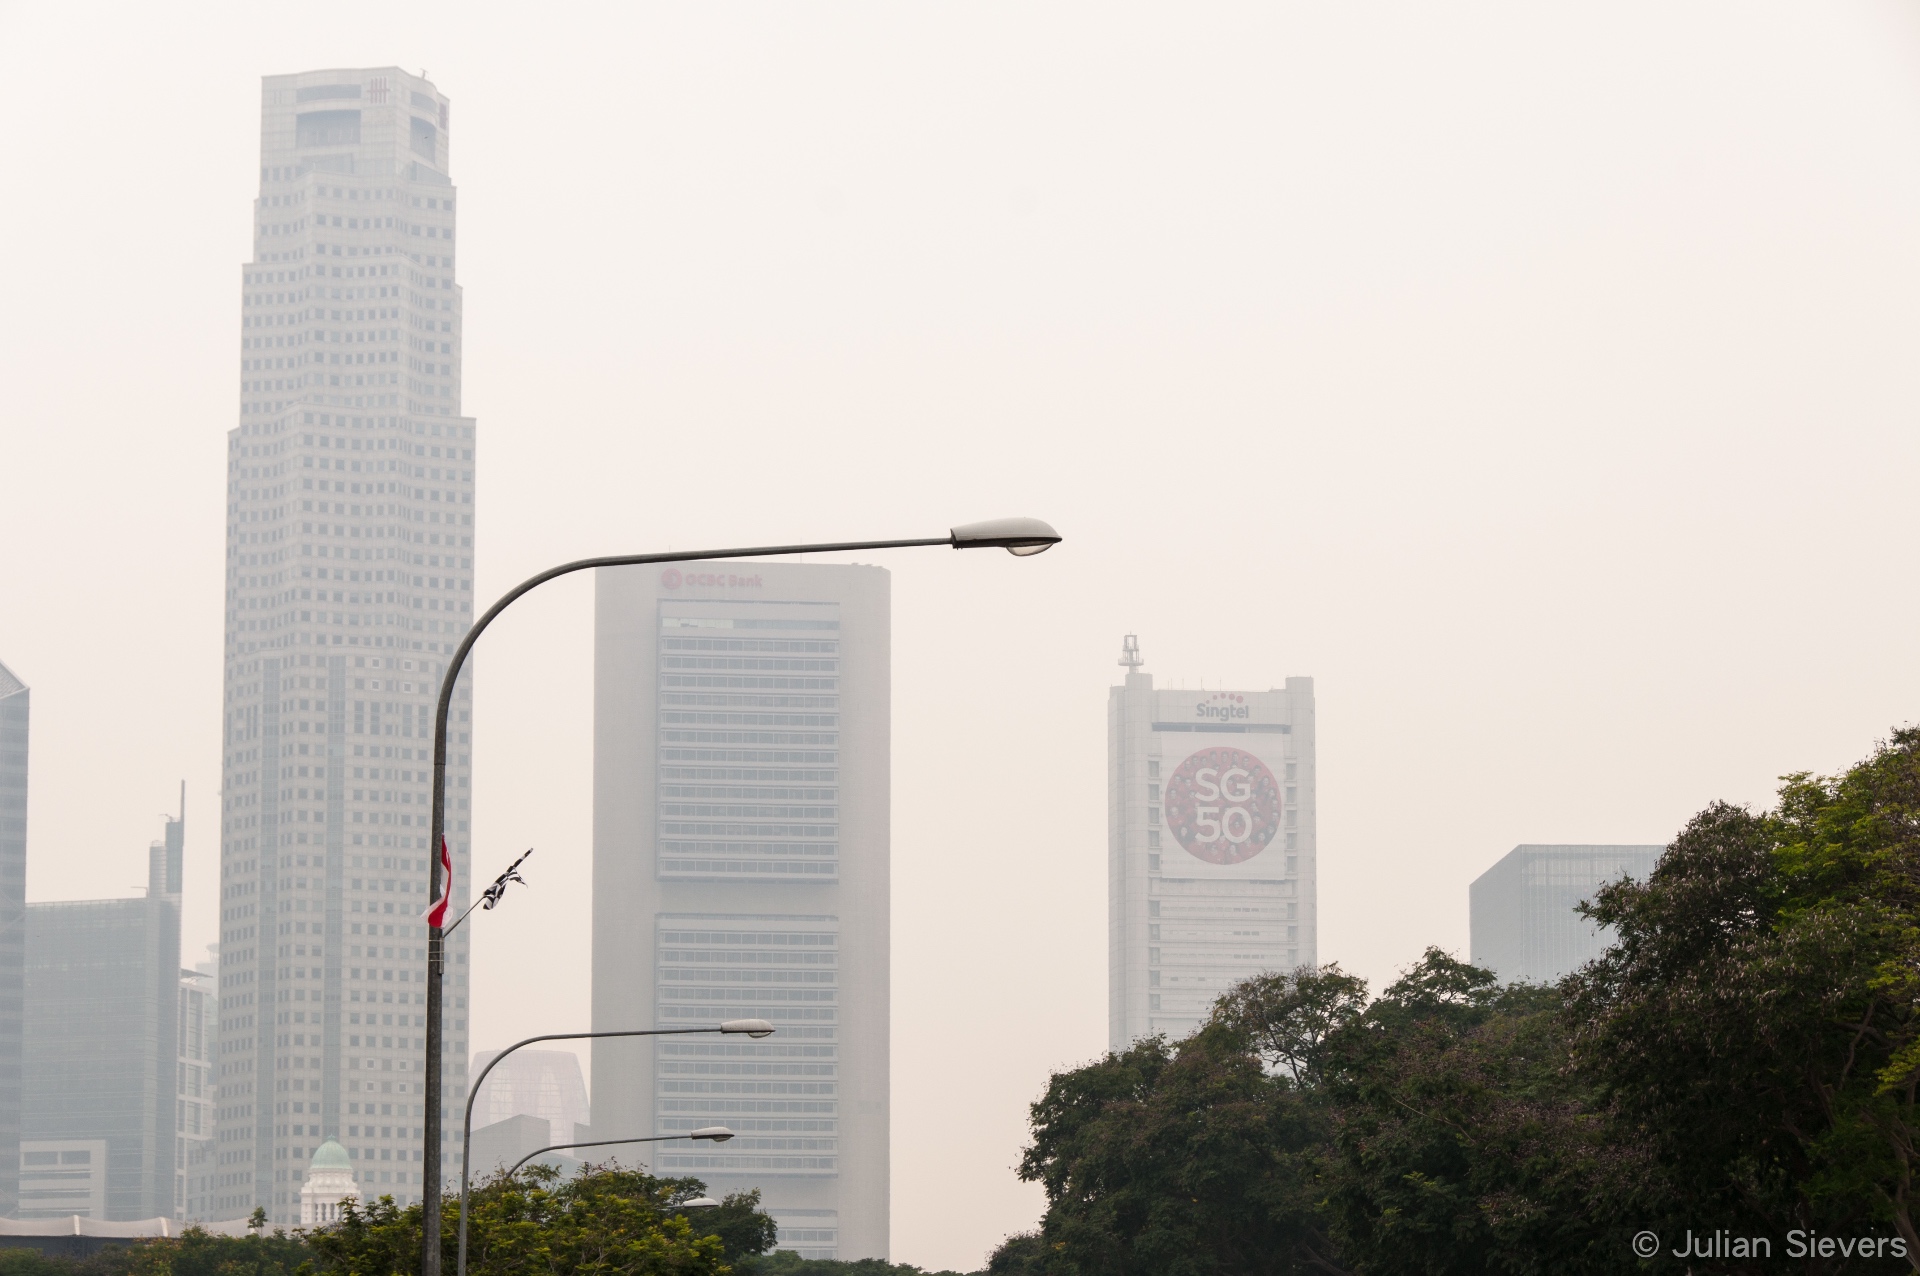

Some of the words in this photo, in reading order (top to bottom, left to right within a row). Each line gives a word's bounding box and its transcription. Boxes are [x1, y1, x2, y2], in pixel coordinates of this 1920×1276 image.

[685, 573, 725, 587] OCBC
[728, 573, 763, 587] Bank
[1196, 702, 1249, 722] Singtel
[1194, 767, 1250, 802] SG
[1194, 806, 1253, 844] 50
